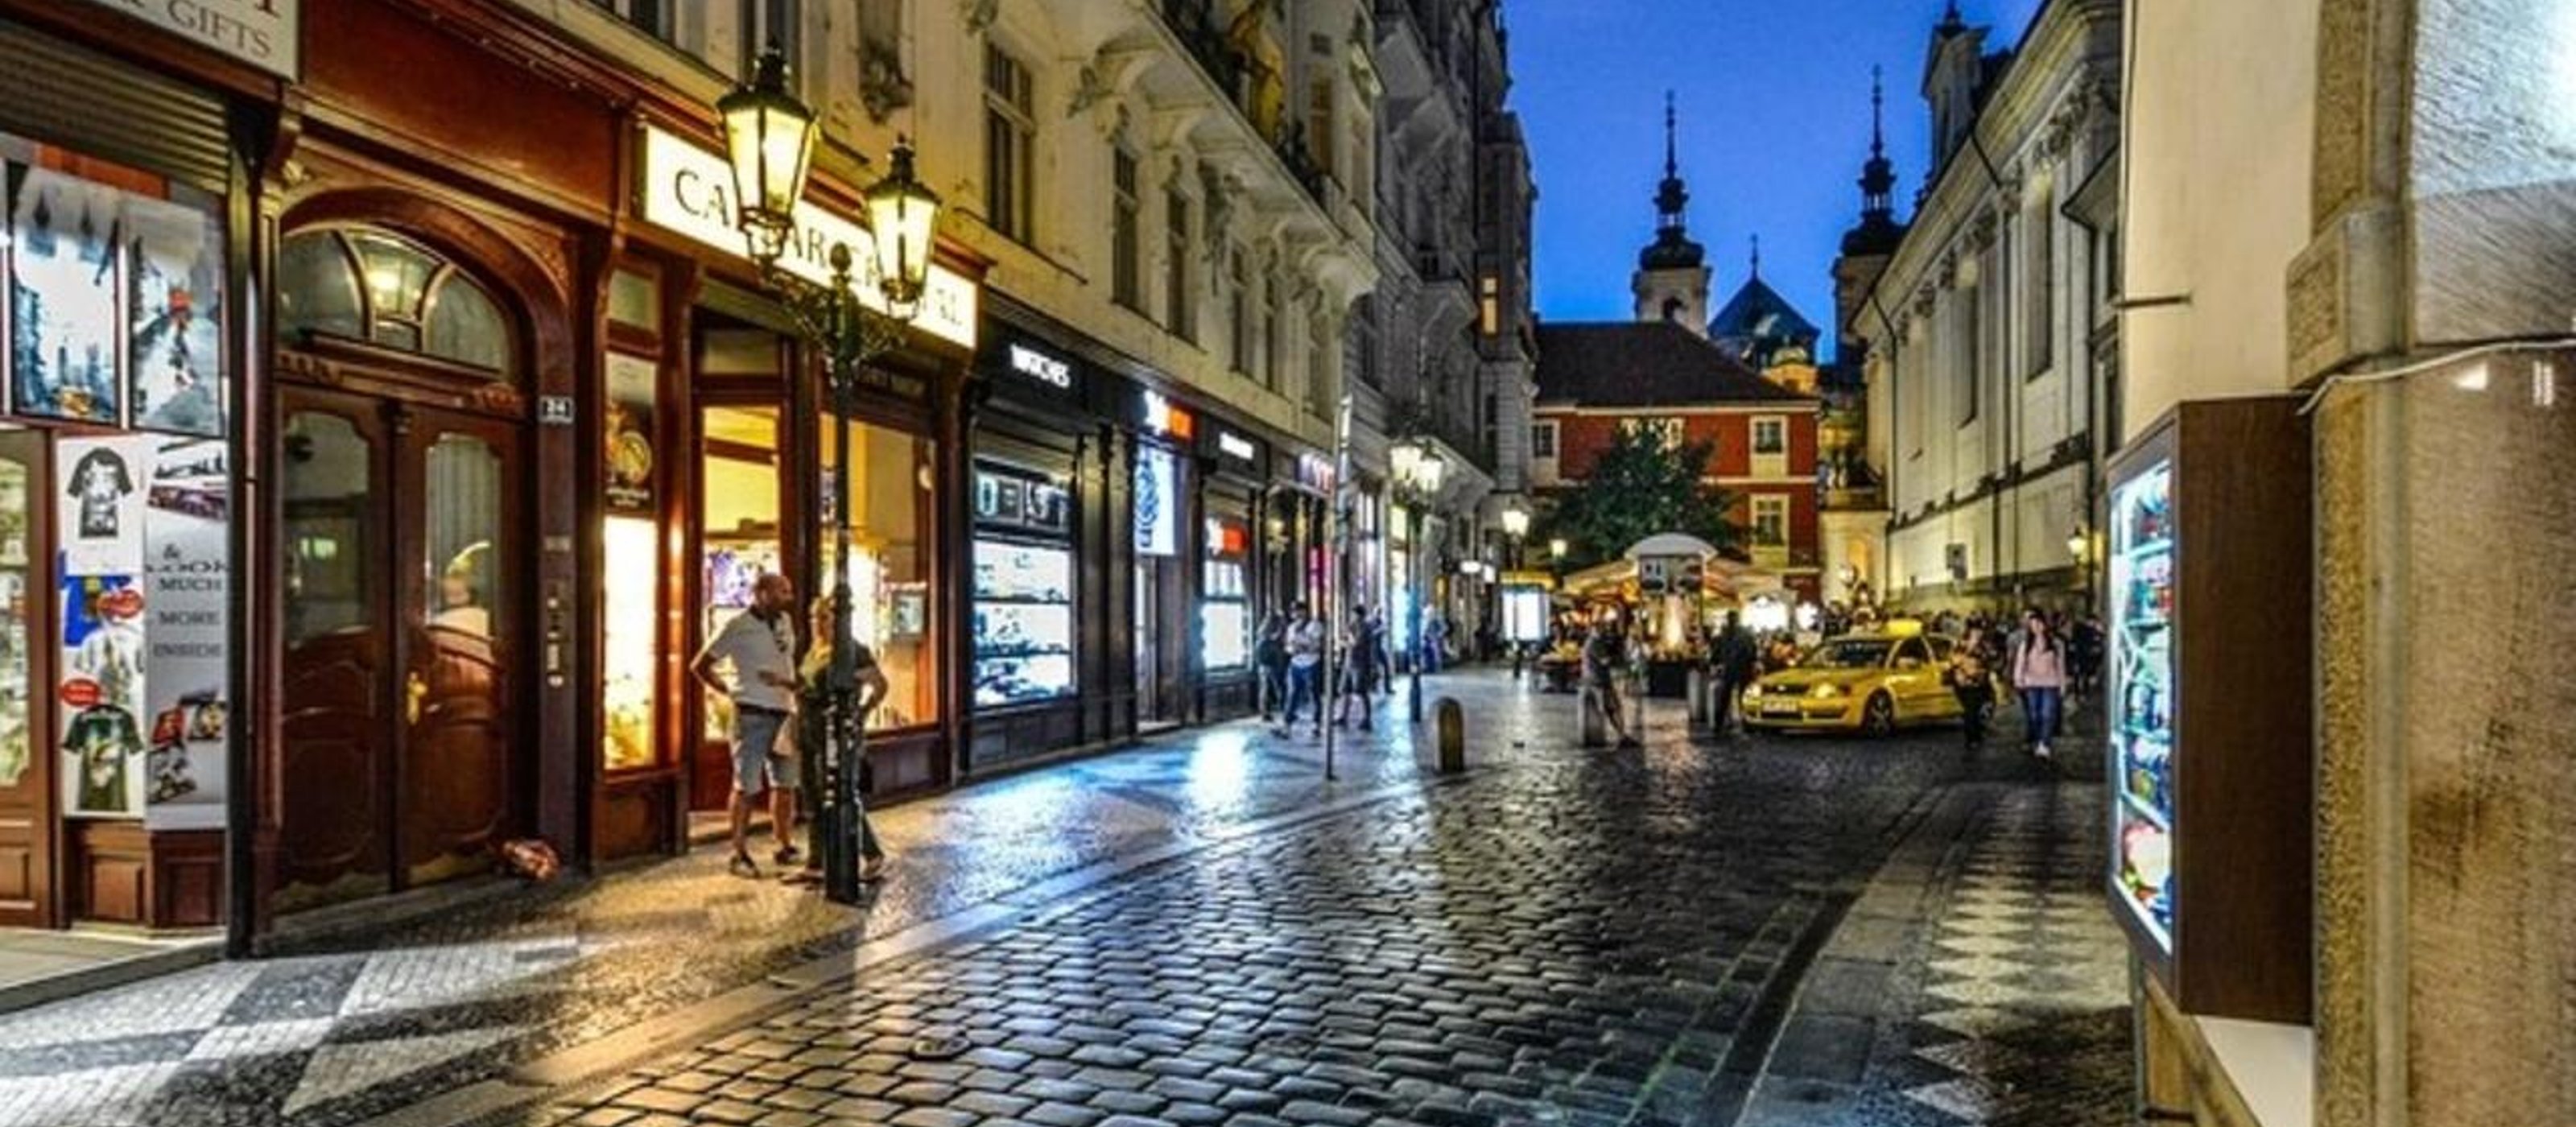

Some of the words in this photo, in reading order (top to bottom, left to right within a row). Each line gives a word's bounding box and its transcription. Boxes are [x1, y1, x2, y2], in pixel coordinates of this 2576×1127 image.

[167, 0, 271, 59] GIFTS
[673, 166, 827, 269] CAAR
[159, 577, 221, 591] MUCH
[159, 610, 221, 624] MORE
